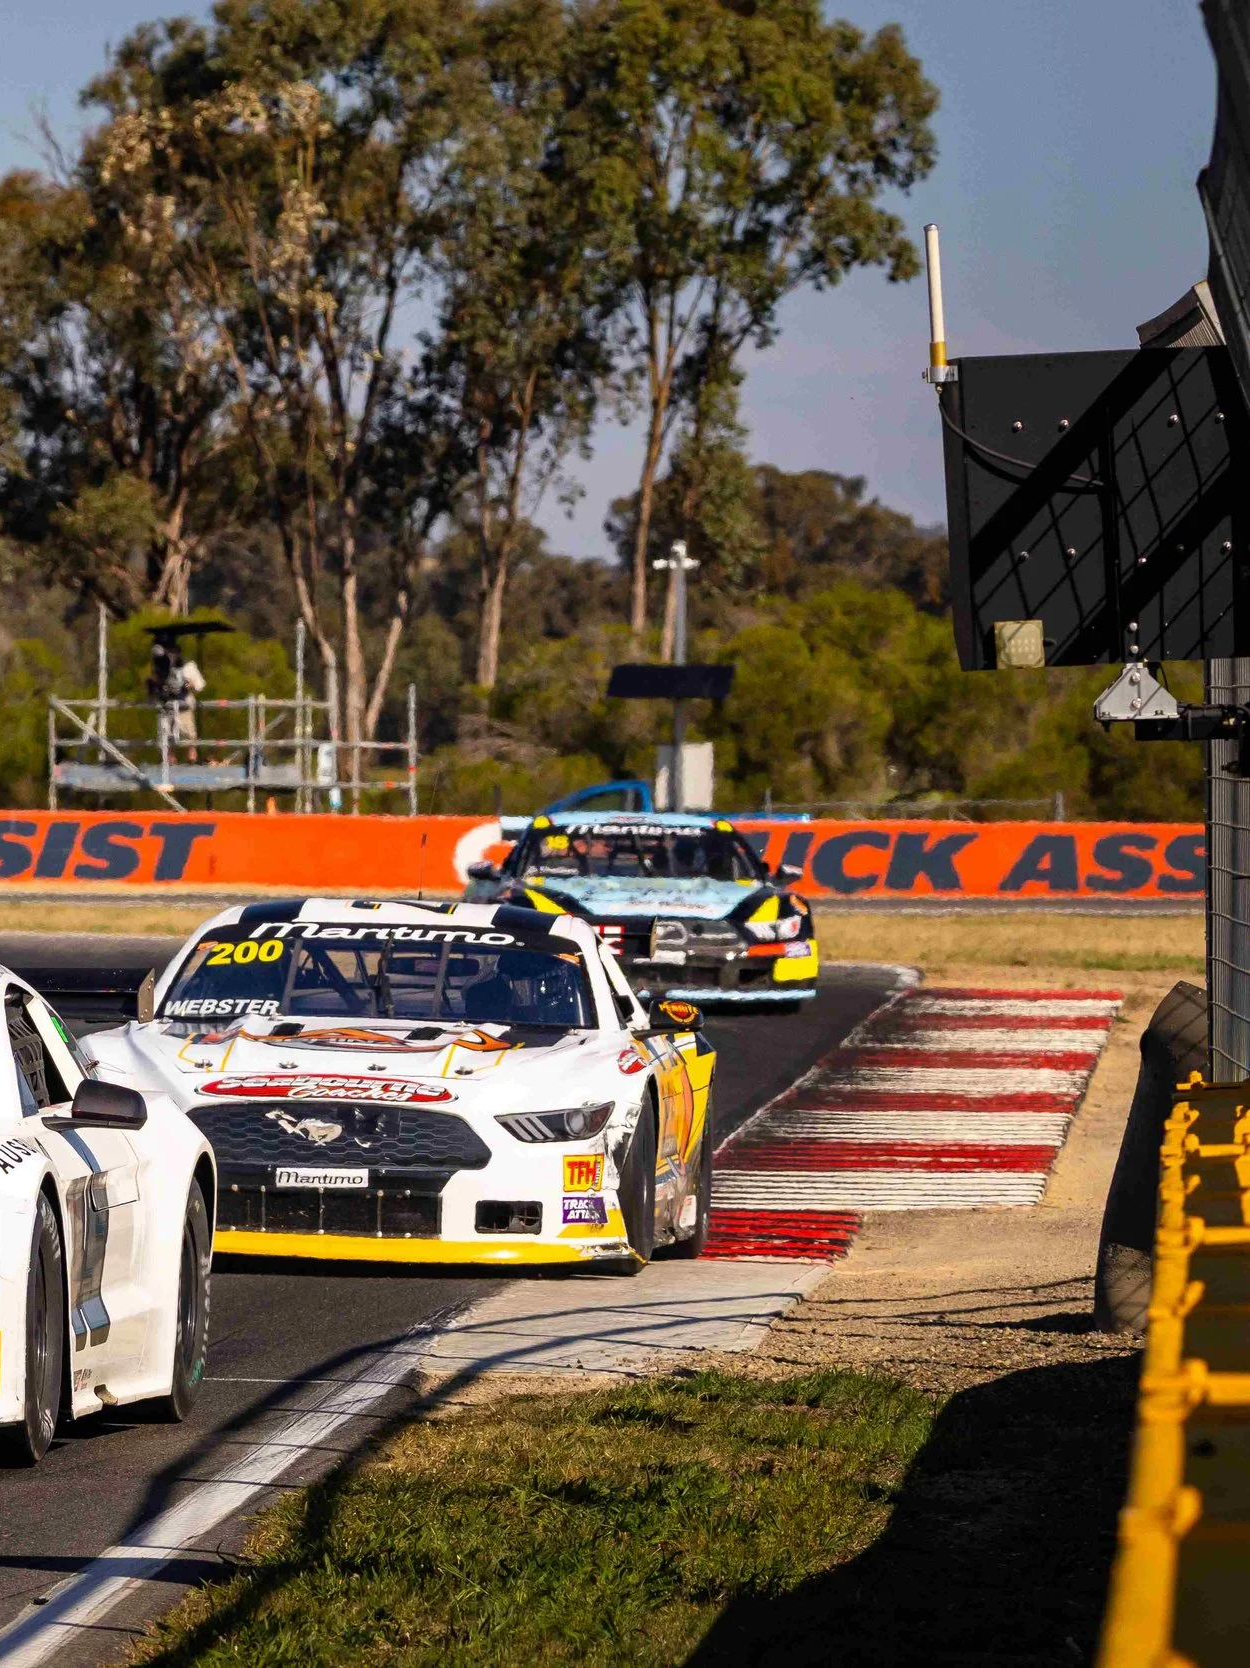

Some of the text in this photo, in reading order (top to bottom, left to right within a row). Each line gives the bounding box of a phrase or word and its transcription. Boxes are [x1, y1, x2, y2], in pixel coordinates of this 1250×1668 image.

[248, 921, 516, 946] Maritimo
[206, 939, 284, 966] 200
[164, 998, 280, 1017] WEBSTER
[288, 1085, 414, 1101] Coaches
[566, 1160, 597, 1186] TFH
